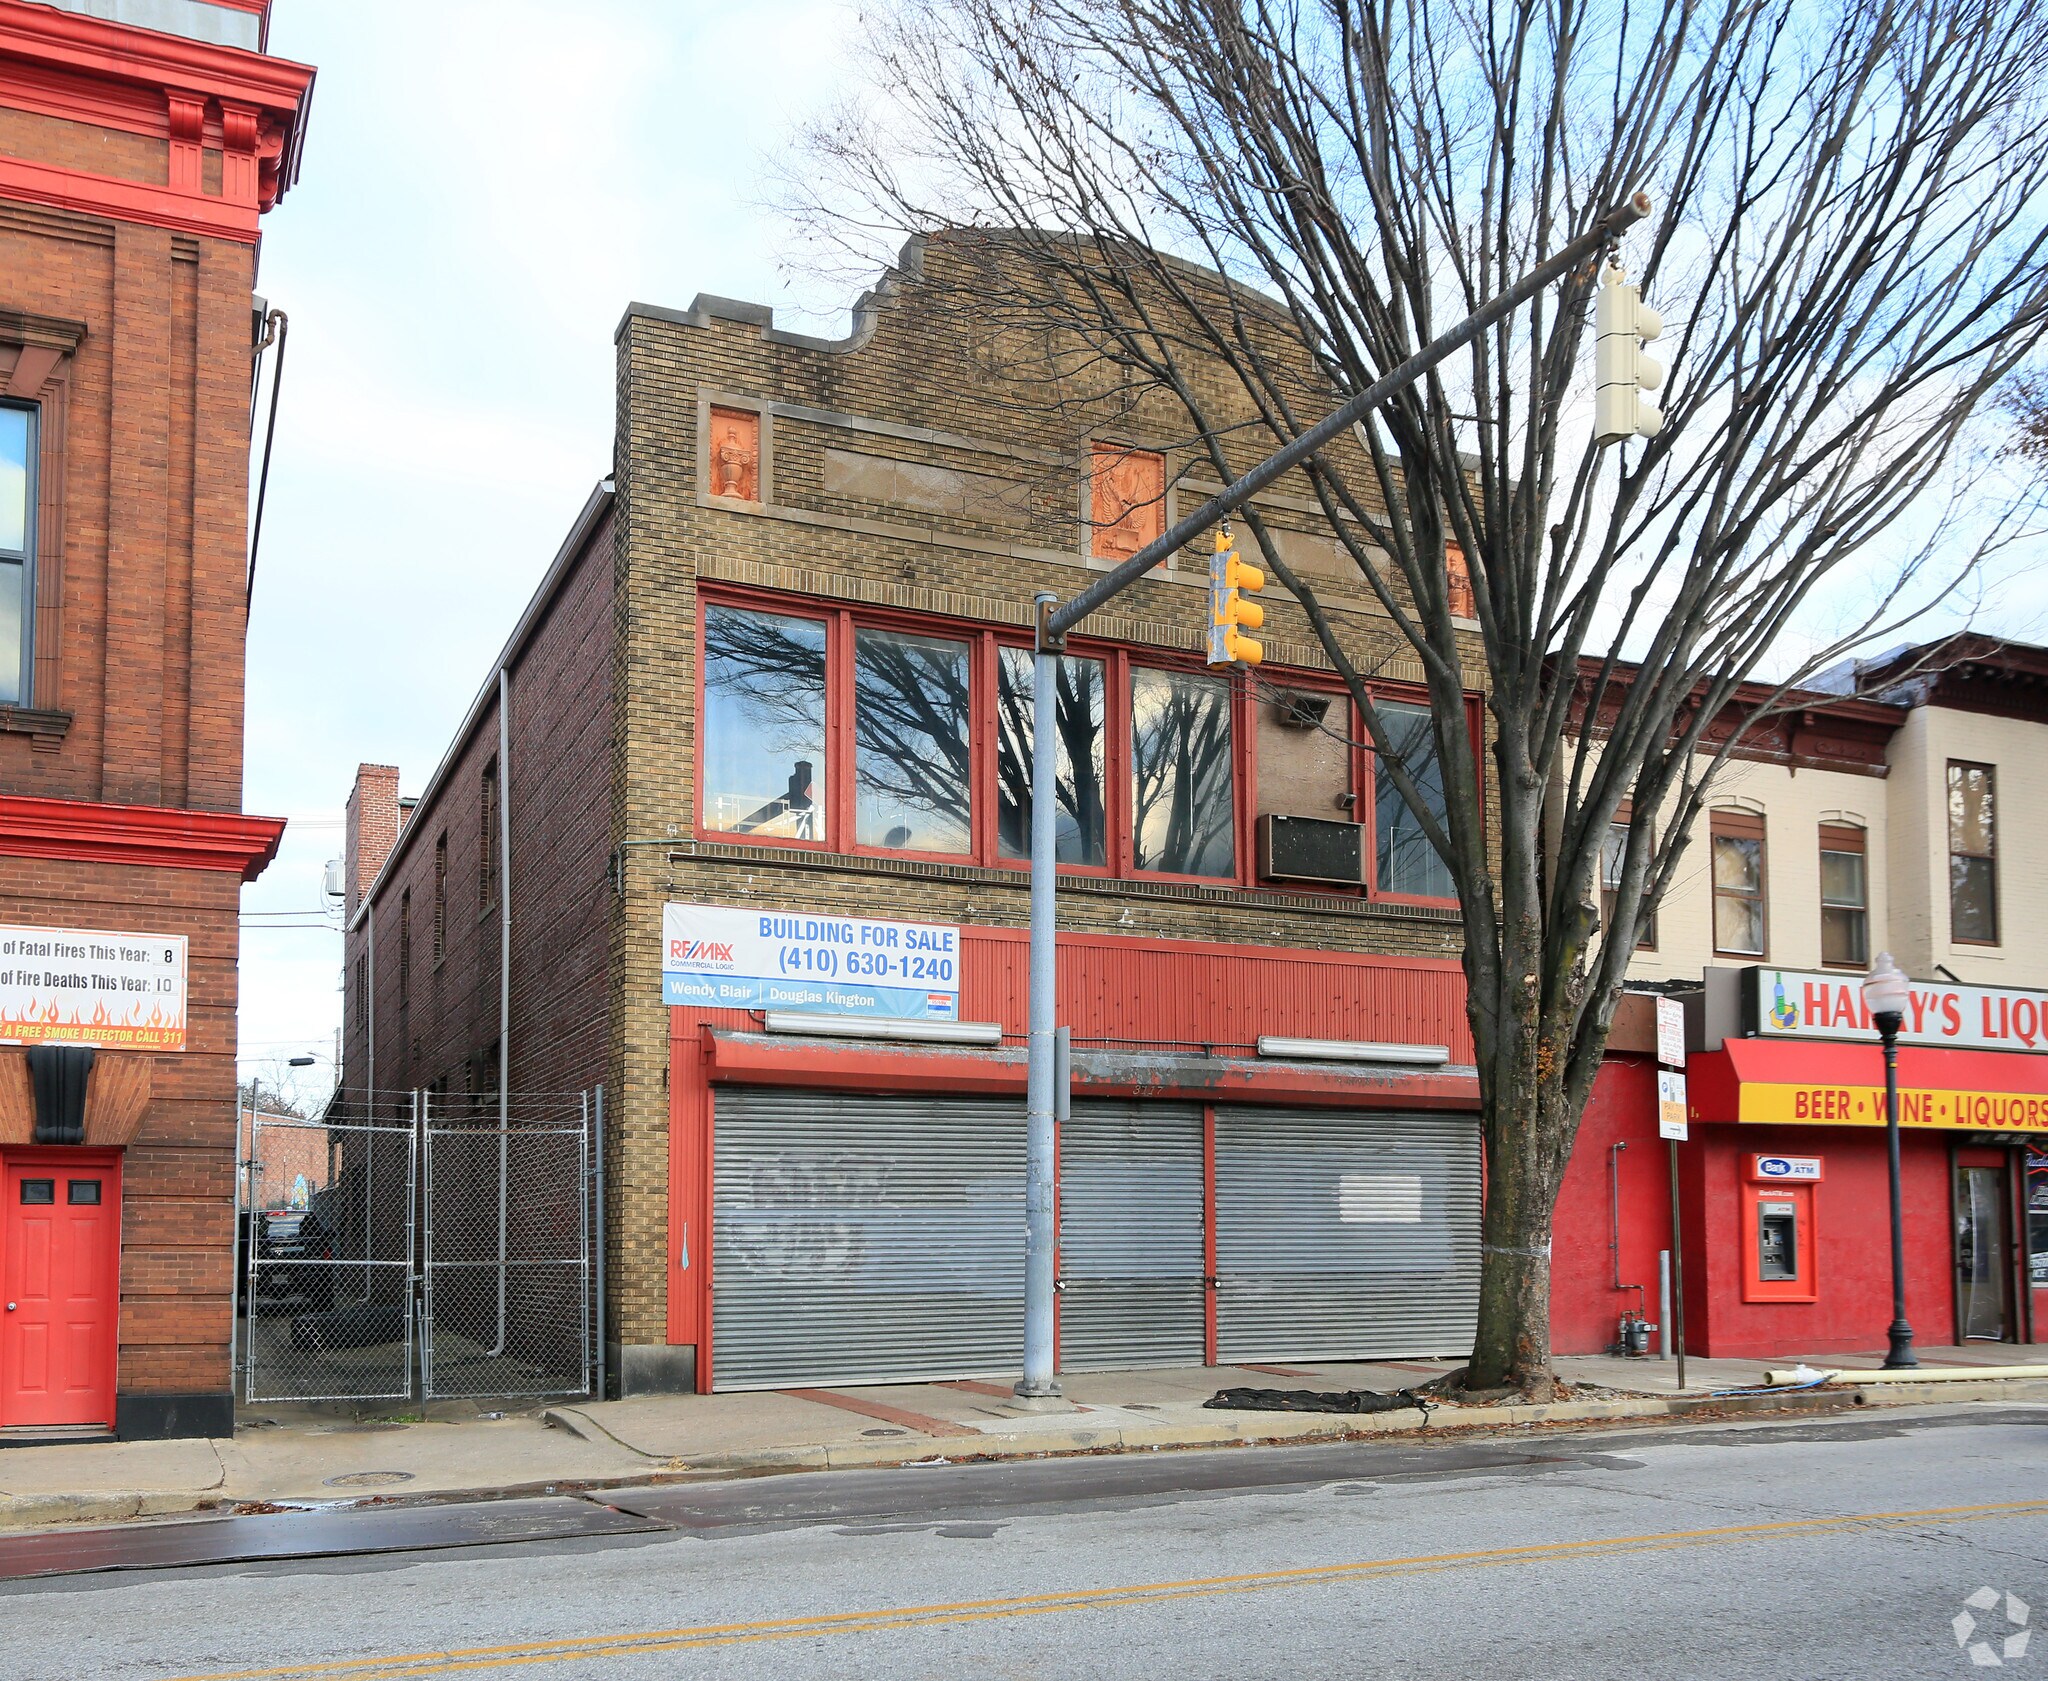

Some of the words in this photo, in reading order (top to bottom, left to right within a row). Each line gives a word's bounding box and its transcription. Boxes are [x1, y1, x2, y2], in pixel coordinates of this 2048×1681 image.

[759, 917, 854, 944] BUILDING
[861, 925, 899, 948] FOR
[905, 929, 953, 952] SALE
[3, 941, 16, 955] of
[19, 941, 51, 957] Fatal
[54, 943, 86, 959] Fires
[89, 945, 116, 961] This
[119, 947, 150, 963] Year:
[164, 950, 173, 963] 8
[670, 940, 734, 962] RE/MAX
[670, 960, 714, 969] COMMERCIAL
[716, 963, 734, 971] LOGIC
[779, 946, 838, 977] (410)
[846, 951, 952, 981] 630-1240
[1, 970, 14, 985] of
[16, 971, 41, 987] Fire
[44, 972, 88, 989] Deaths
[91, 974, 117, 991] This
[120, 976, 151, 992] Year:
[157, 978, 172, 992] 10
[671, 981, 716, 999] Wendy
[720, 984, 752, 999] Blair
[770, 988, 822, 1004] Douglas
[826, 991, 875, 1008] Kington
[1804, 982, 1961, 1037] HAY'S
[5, 1025, 12, 1037] A
[15, 1025, 42, 1039] FREE
[44, 1026, 79, 1040] SMOKE
[82, 1028, 133, 1042] DETECTOR
[136, 1030, 160, 1043] CALL
[163, 1031, 183, 1044] 311
[1795, 1090, 1850, 1120] BEER
[1794, 1166, 1815, 1174] ATM
